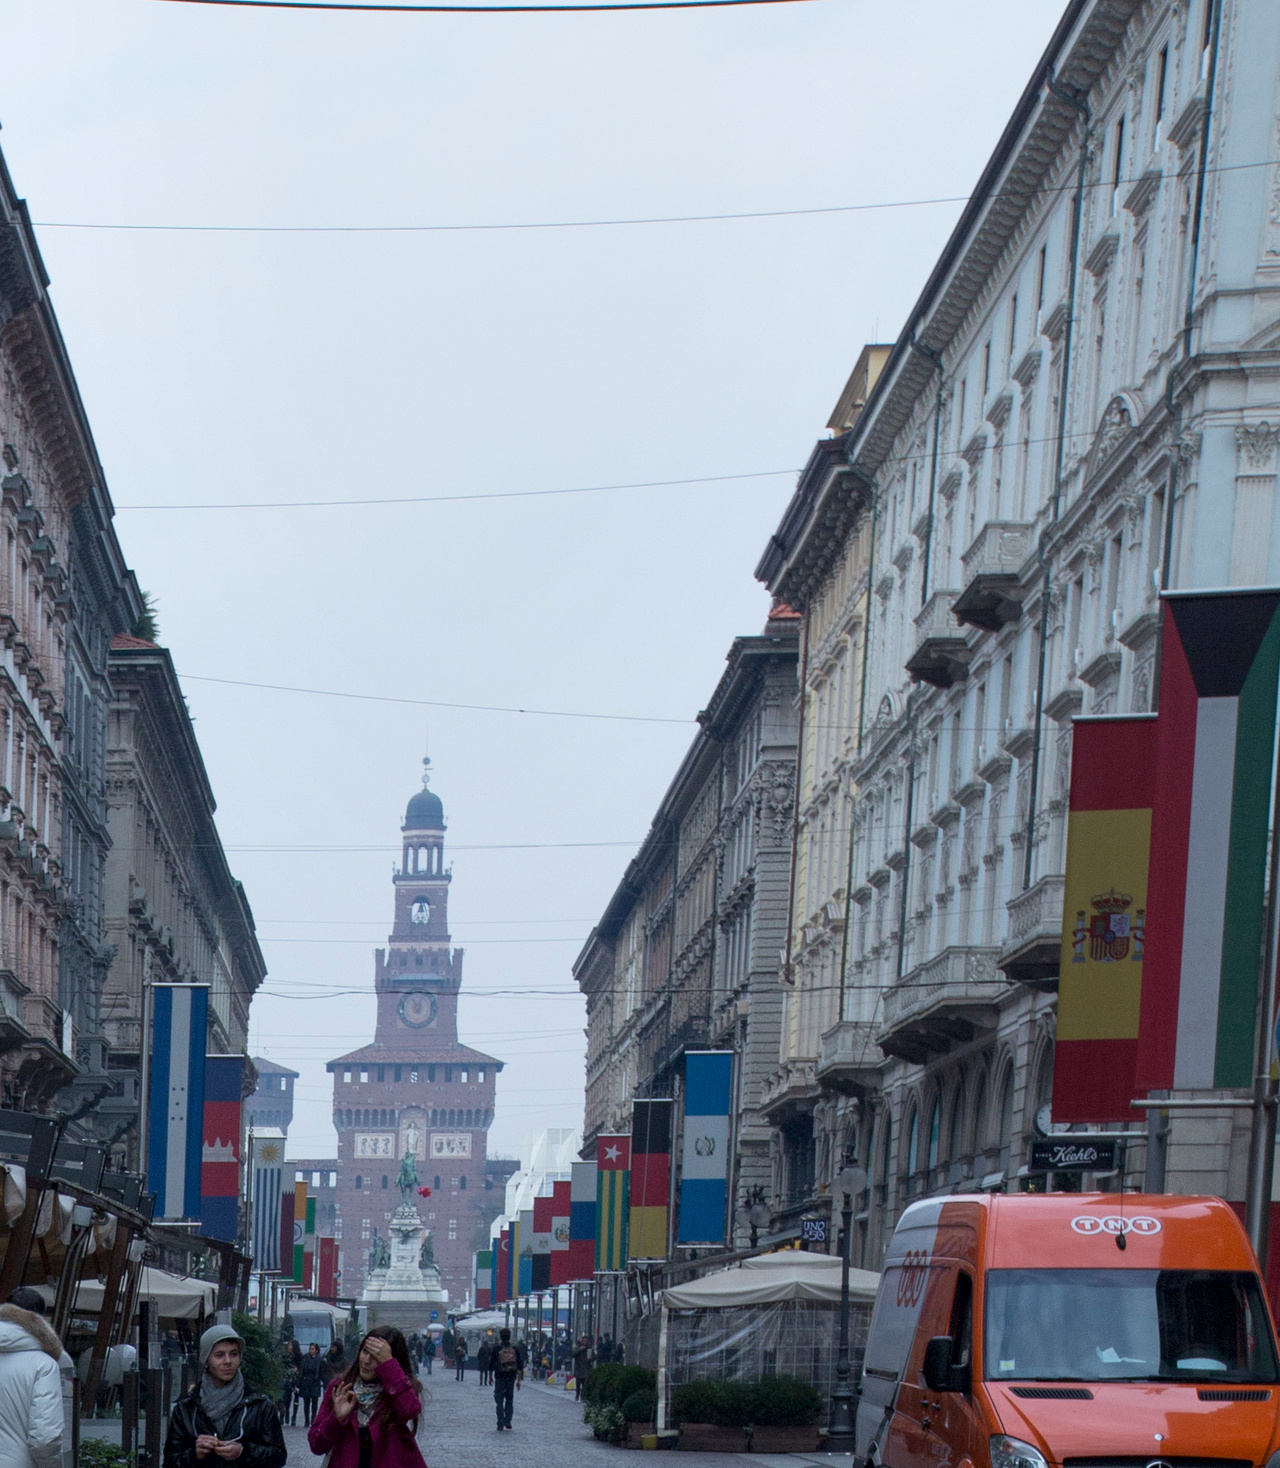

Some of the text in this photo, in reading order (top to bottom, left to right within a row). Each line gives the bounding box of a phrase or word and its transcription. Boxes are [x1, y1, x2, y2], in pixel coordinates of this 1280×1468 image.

[1049, 1145, 1098, 1164] Kiehl's
[803, 1221, 826, 1232] UNO
[1074, 1217, 1158, 1233] TNT
